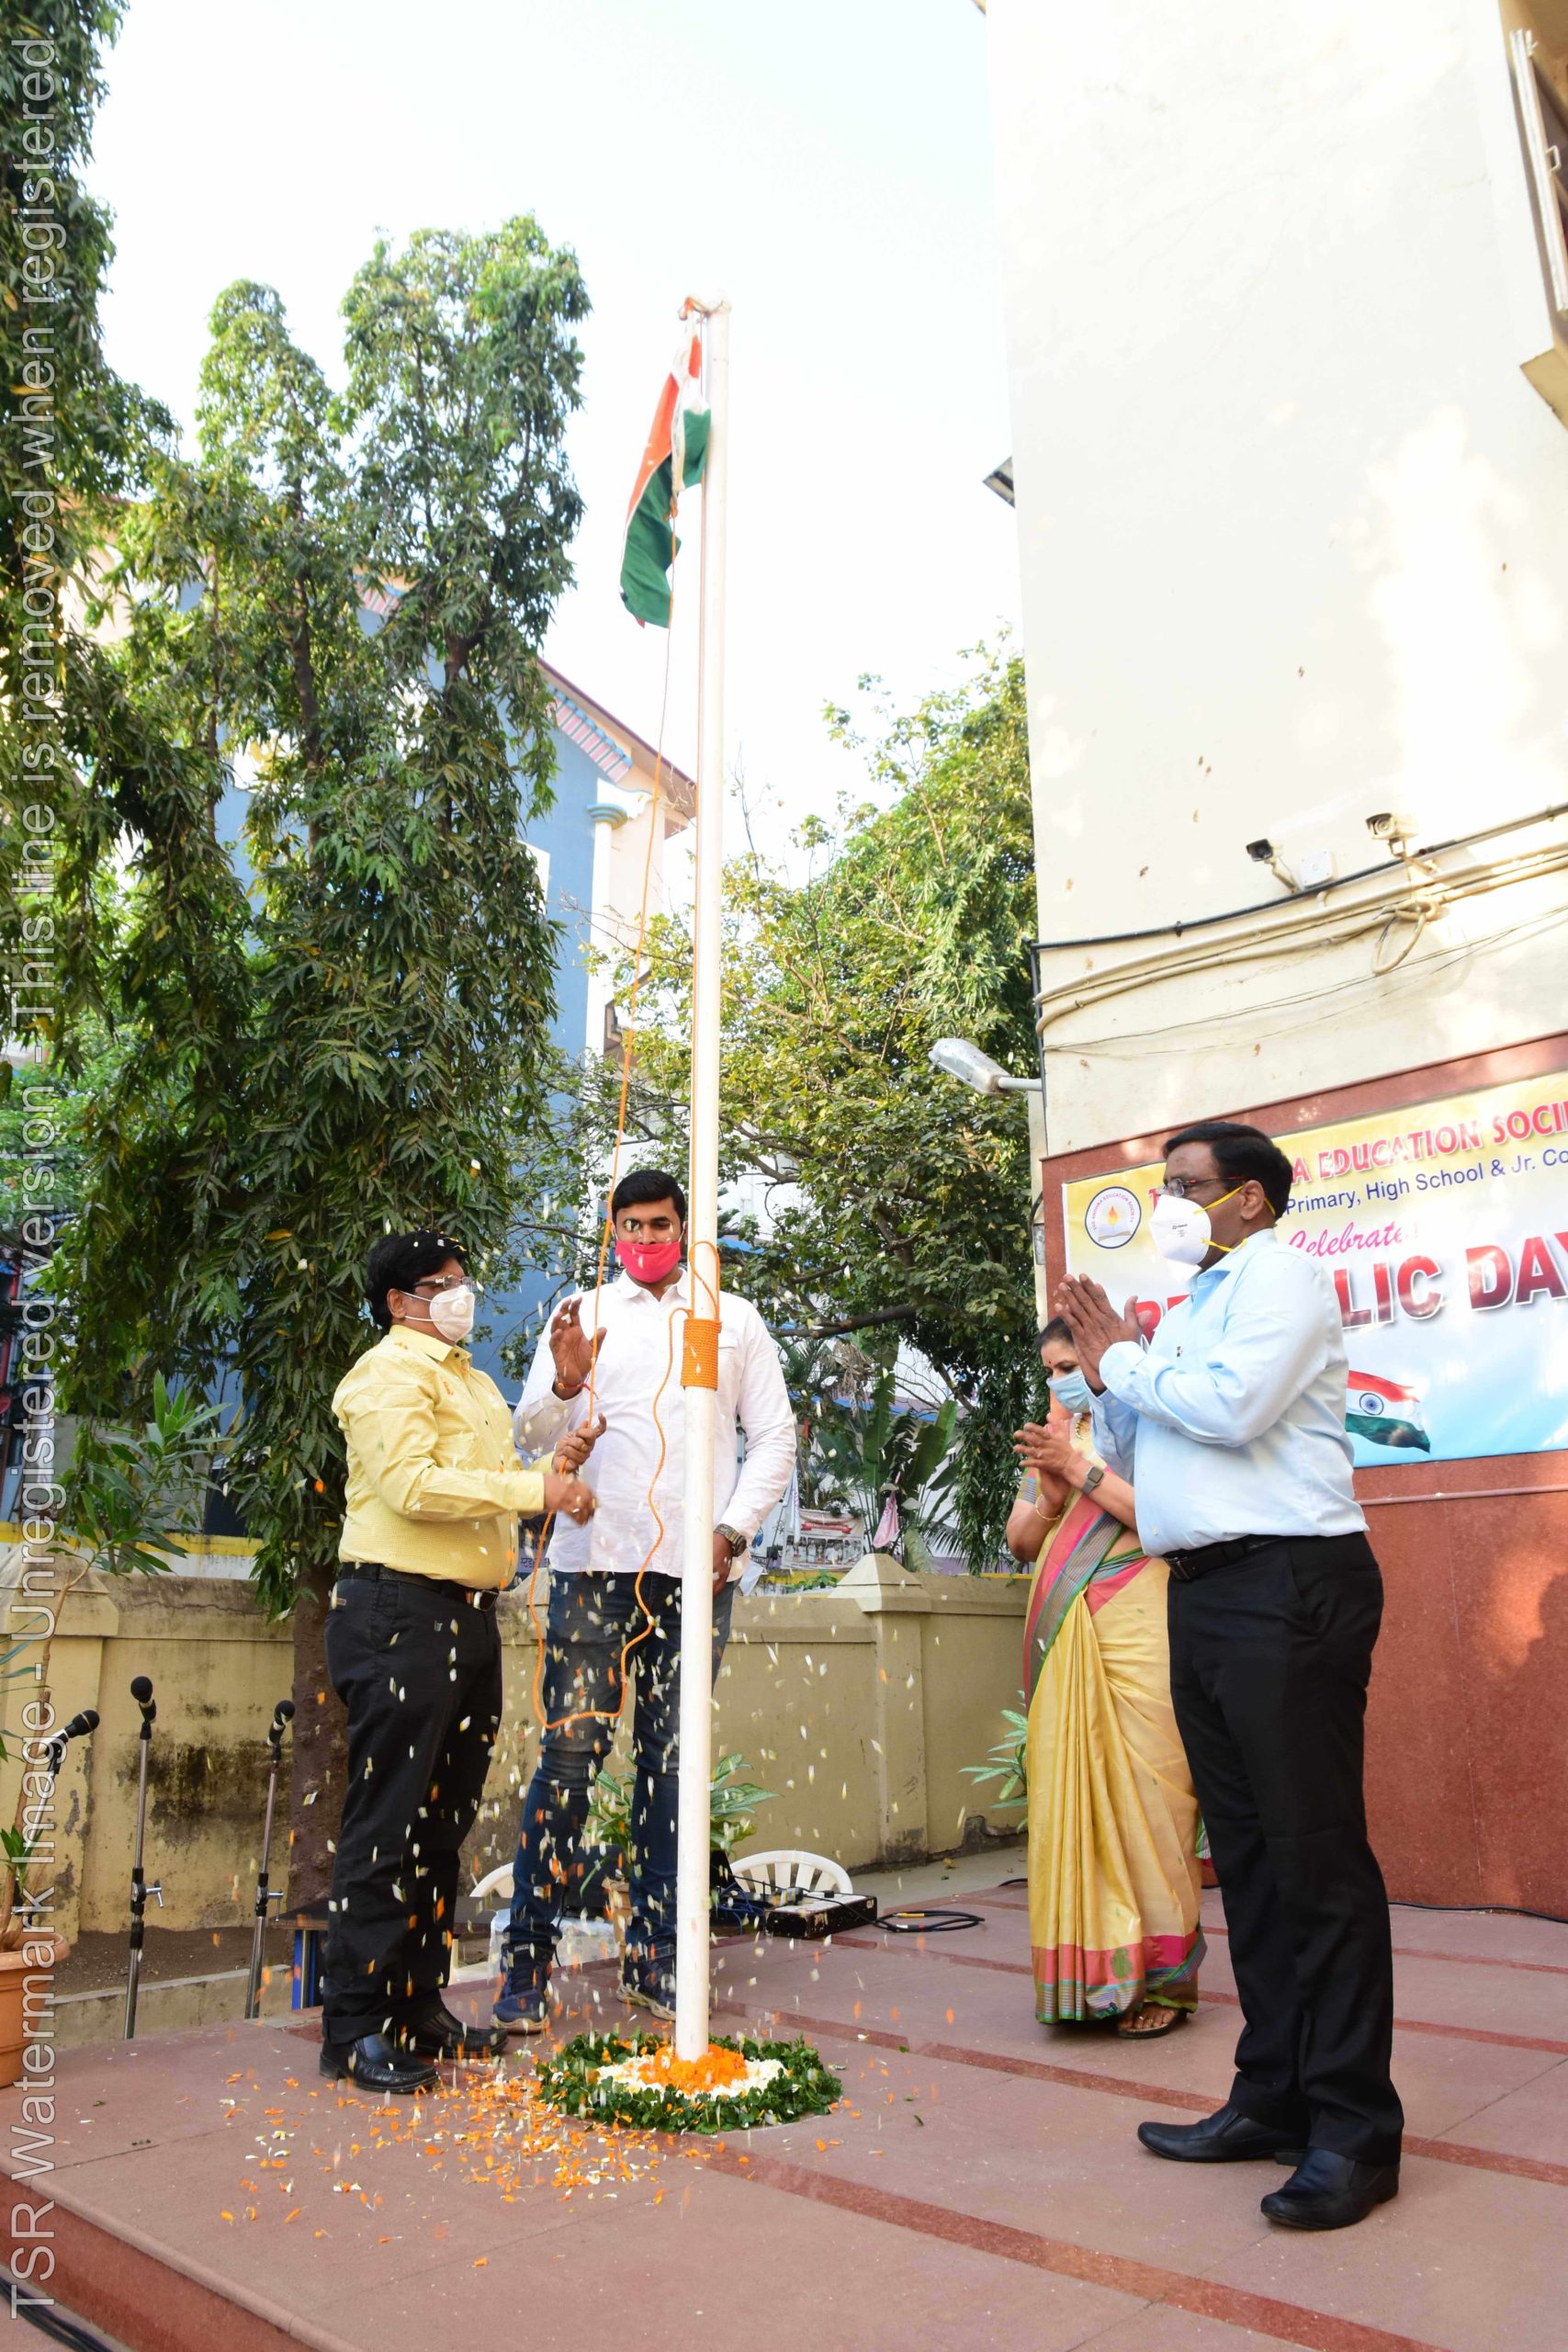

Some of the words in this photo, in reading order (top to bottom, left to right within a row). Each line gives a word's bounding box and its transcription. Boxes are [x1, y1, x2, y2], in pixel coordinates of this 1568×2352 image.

[1318, 1119, 1483, 1179] EDUCATION
[1492, 1101, 1568, 1144] SOCI
[1366, 1177, 1410, 1201] High
[1416, 1162, 1483, 1191] School
[1491, 1159, 1506, 1177] &
[1511, 1155, 1535, 1173] Jr.
